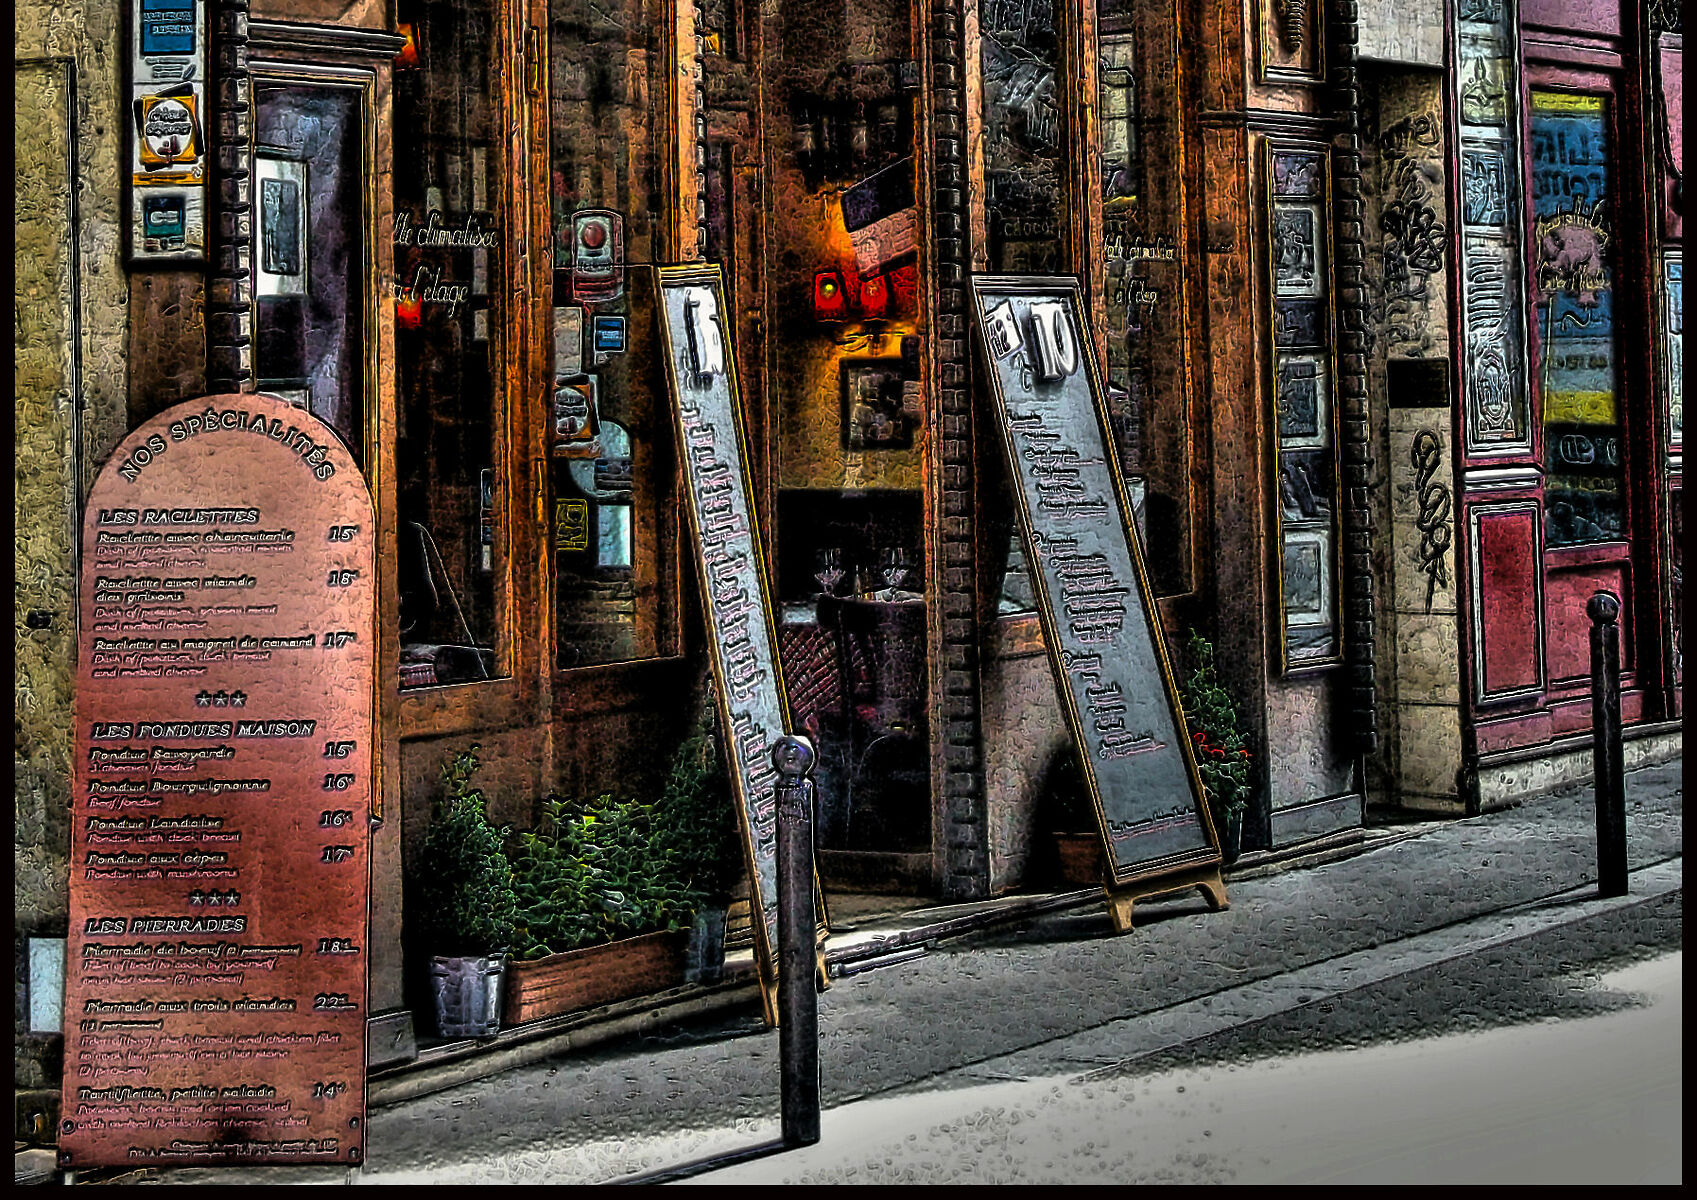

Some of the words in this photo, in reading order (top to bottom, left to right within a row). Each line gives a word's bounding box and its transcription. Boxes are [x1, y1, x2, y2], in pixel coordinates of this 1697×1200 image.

[118, 433, 168, 483] NOS
[169, 407, 336, 482] SPÉCIALITÉS
[99, 508, 138, 525] LES
[142, 507, 260, 525] RACLETTES
[97, 531, 162, 544] Raclette
[165, 532, 201, 543] avec
[204, 529, 295, 544] charcuterie
[96, 576, 161, 589] Raclette
[163, 577, 200, 589] avec
[203, 575, 256, 589] viande
[94, 638, 157, 651] Raclette
[261, 634, 315, 649] canard
[92, 722, 133, 738] LES
[137, 721, 233, 738] FONDUES
[237, 720, 315, 738] MAISON
[90, 747, 148, 760] Fondue
[151, 746, 235, 762] Savoyarde
[89, 779, 147, 793] Fondue
[150, 779, 271, 796] Bourguignonne
[87, 817, 146, 831] Fondue
[149, 815, 223, 830] Landaise
[86, 851, 145, 865] Fondue
[148, 853, 180, 864] aux
[86, 918, 127, 935] LES
[130, 916, 247, 935] PIERRADES
[83, 944, 153, 957] Pierrade
[85, 999, 154, 1013] Pierrade
[156, 1001, 188, 1013] aux
[191, 998, 231, 1012] trois
[233, 996, 297, 1012] viandes
[170, 1086, 218, 1101] petite
[220, 1084, 276, 1099] salade
